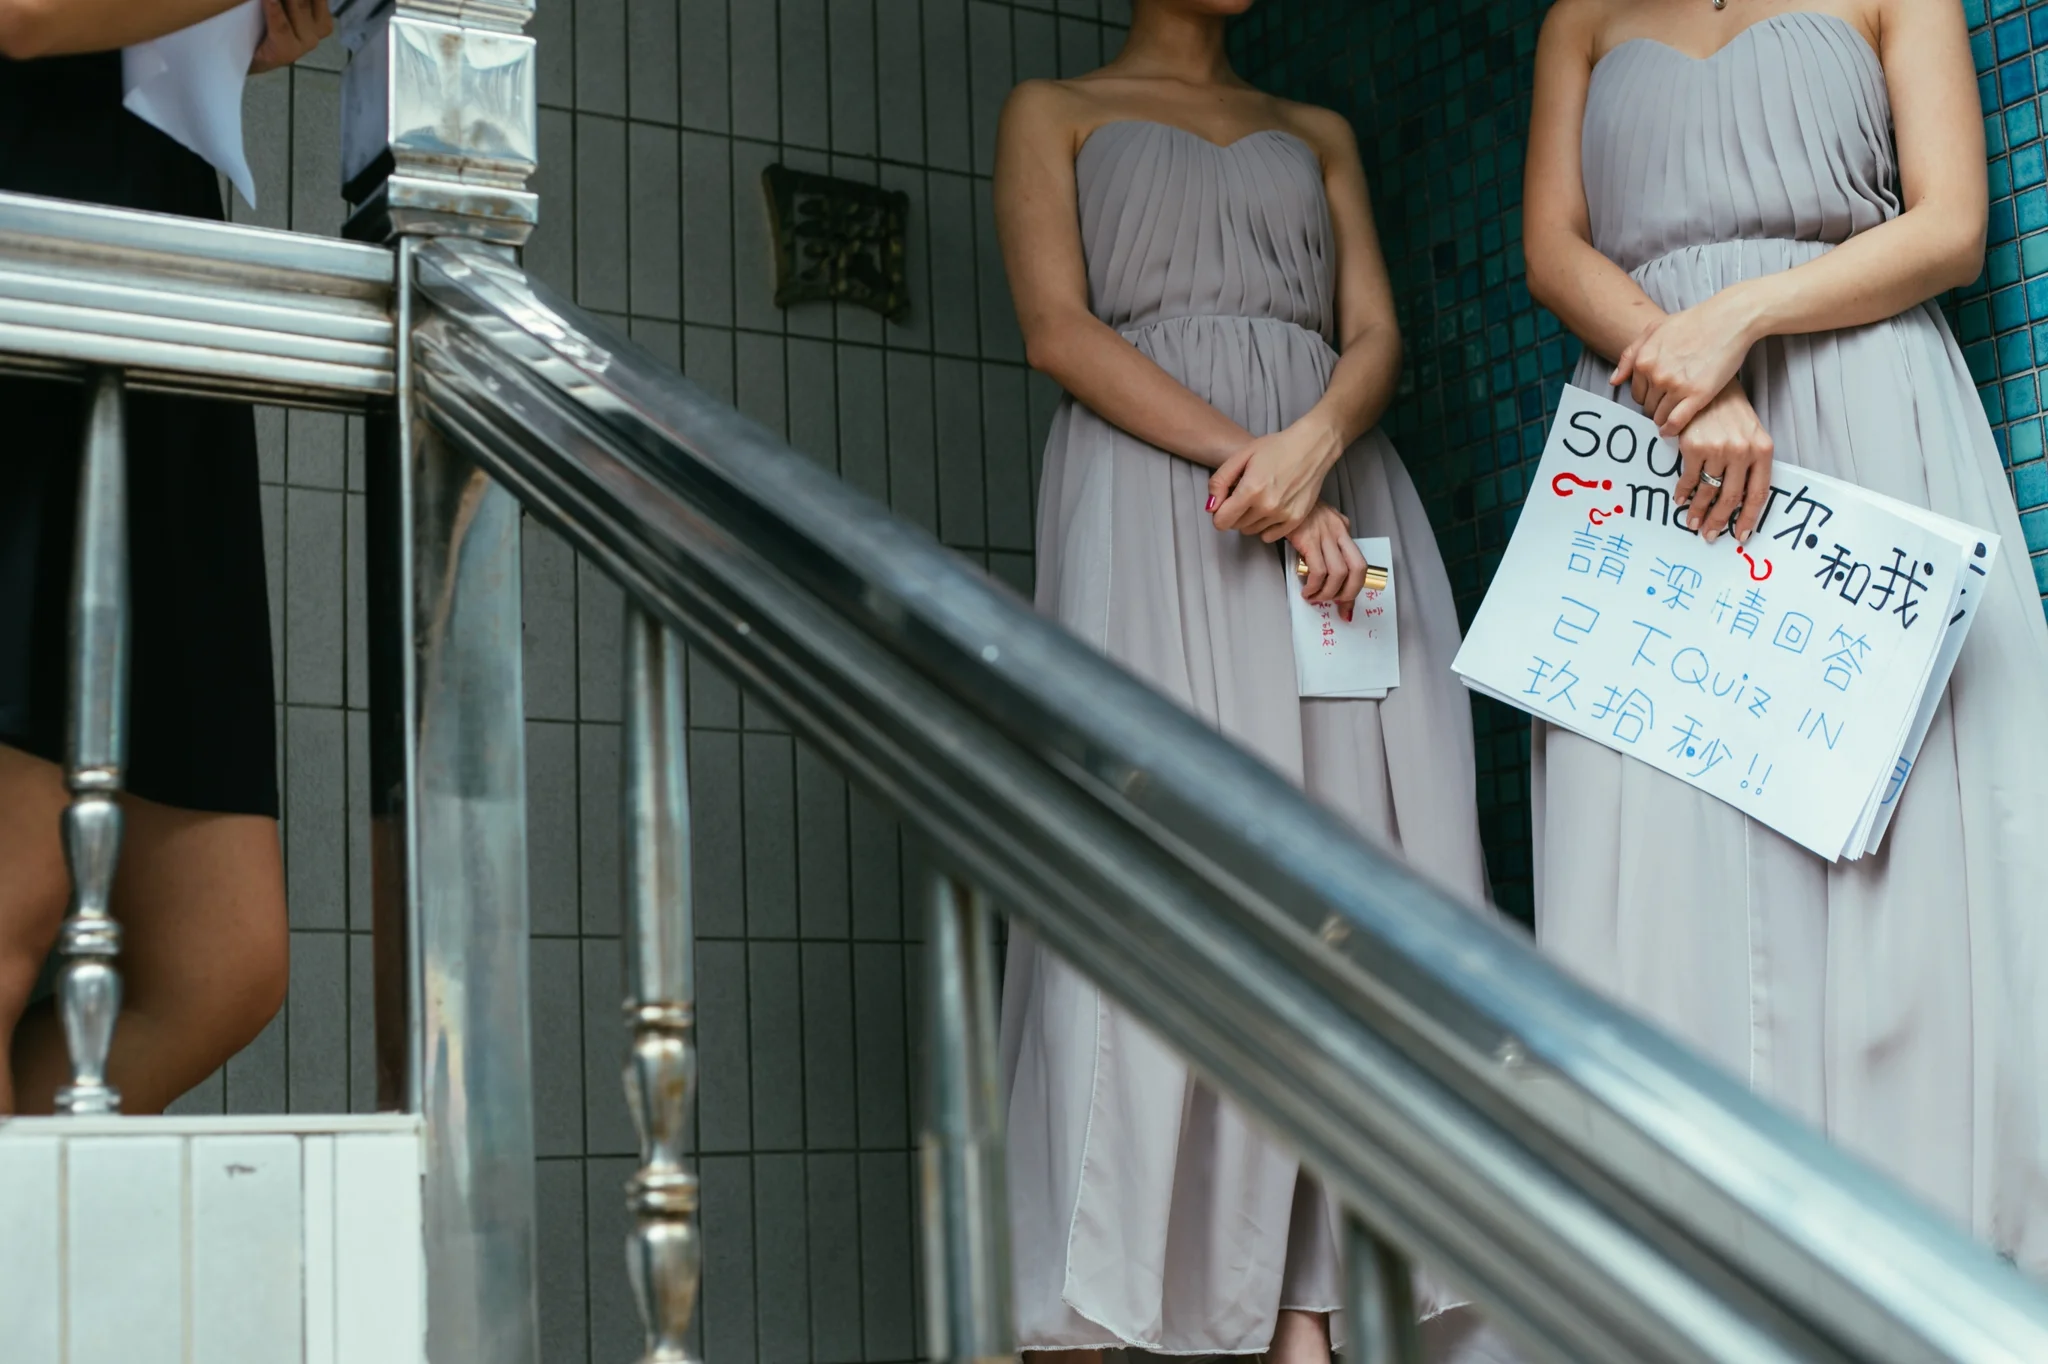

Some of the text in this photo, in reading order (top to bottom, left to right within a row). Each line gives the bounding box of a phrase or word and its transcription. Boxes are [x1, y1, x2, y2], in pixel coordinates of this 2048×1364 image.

[1562, 410, 1683, 478] Sou
[1626, 483, 1753, 541] mae
[1797, 708, 1845, 750] IN
